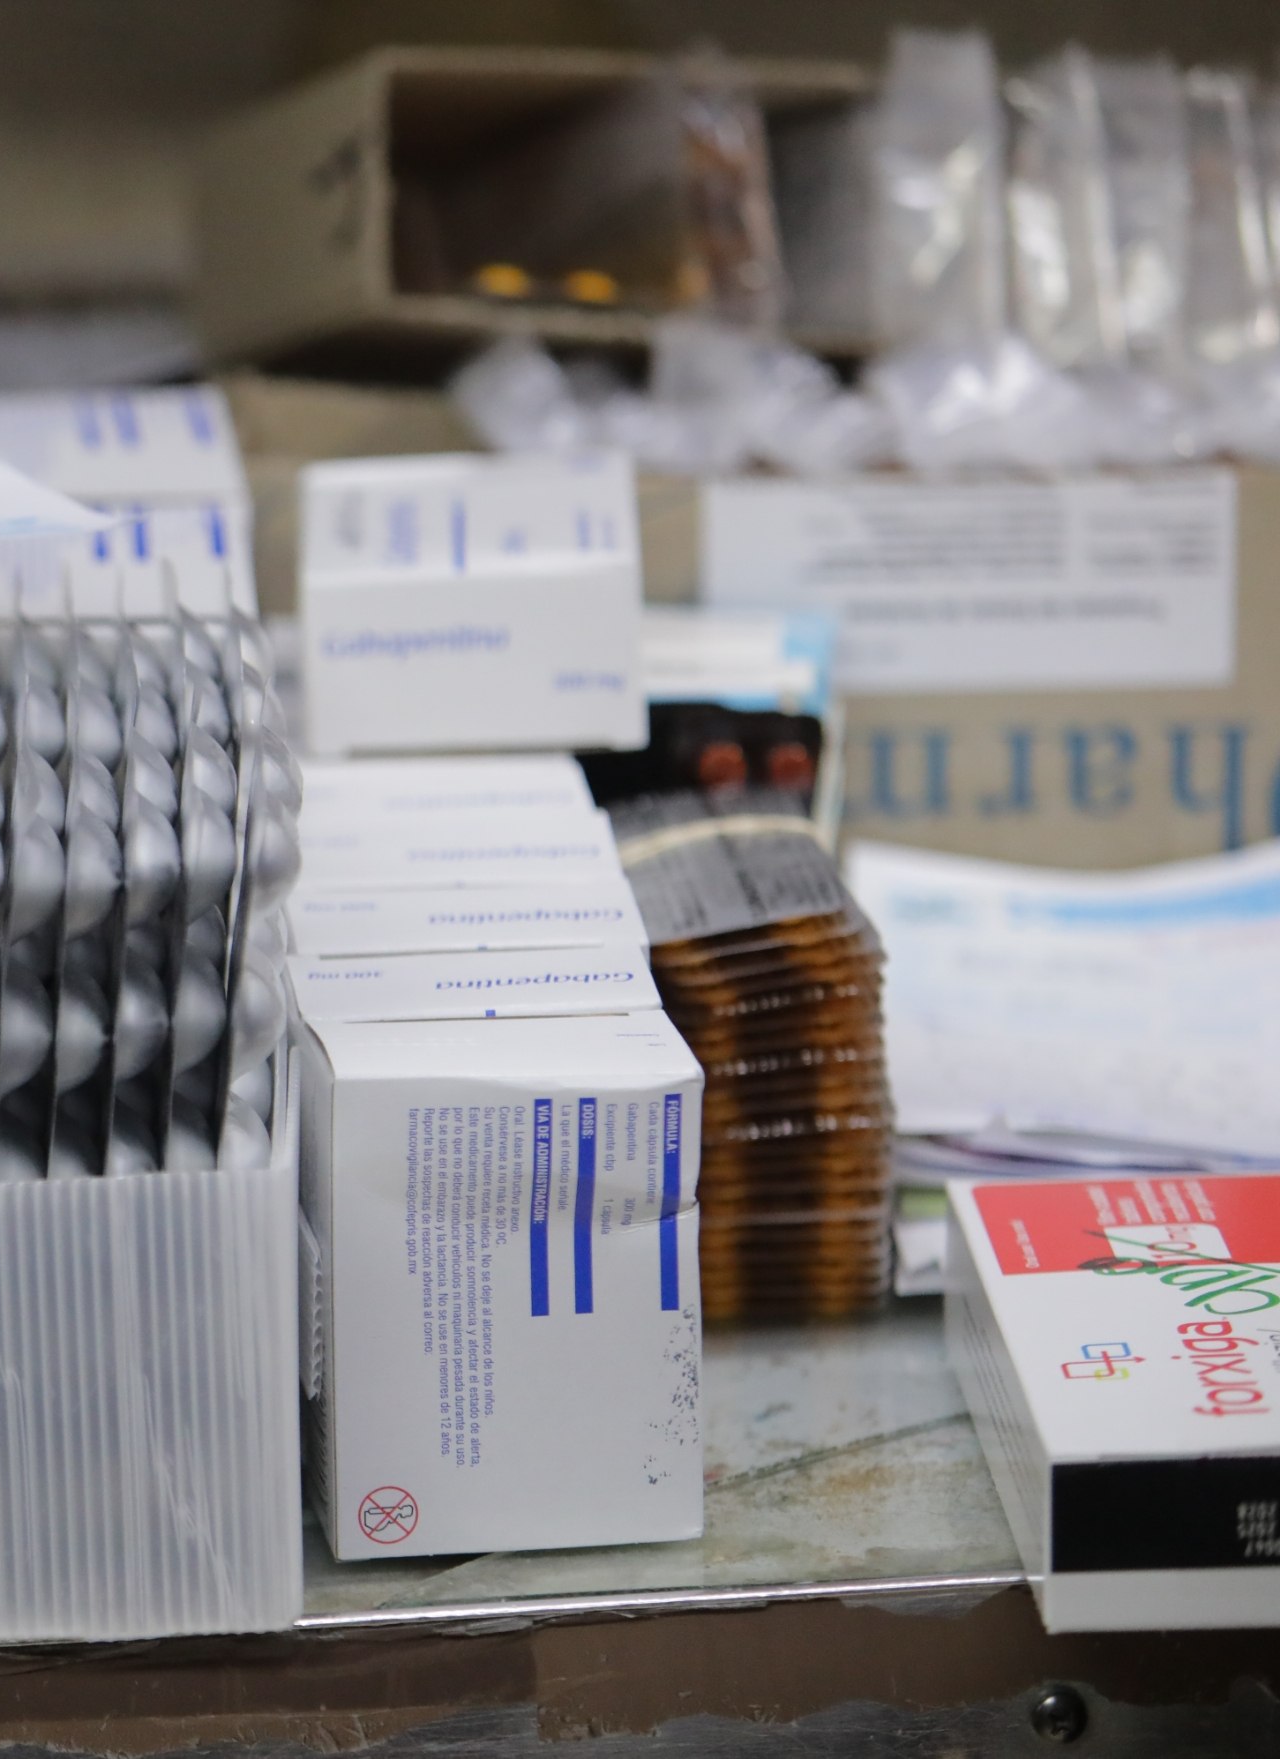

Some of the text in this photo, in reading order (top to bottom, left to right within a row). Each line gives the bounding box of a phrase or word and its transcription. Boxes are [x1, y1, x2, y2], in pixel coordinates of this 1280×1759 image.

[435, 971, 635, 990] Gabapentina
[439, 1107, 450, 1121] No
[452, 1107, 463, 1123] por
[468, 1107, 480, 1128] Este
[561, 1105, 573, 1117] La
[648, 1101, 660, 1126] Cada
[422, 1107, 435, 1146] Reporte
[439, 1124, 448, 1136] se
[453, 1125, 464, 1135] lo
[559, 1119, 571, 1137] que
[581, 1104, 595, 1139] DOSIS:
[605, 1103, 618, 1150] Excipiente
[625, 1102, 639, 1161] Gabapentina
[666, 1100, 680, 1154] FÓRMULA:
[499, 1106, 511, 1162] Consérvese
[561, 1139, 572, 1148] el
[423, 1148, 435, 1162] las
[439, 1138, 449, 1155] use
[452, 1137, 463, 1155] que
[513, 1131, 526, 1159] Léase
[439, 1157, 448, 1169] en
[453, 1157, 462, 1169] no
[467, 1130, 480, 1193] medicamento
[534, 1105, 551, 1225] VÍA DE ADMINISTRACIÓN:
[559, 1150, 572, 1184] médico
[604, 1154, 616, 1172] cbp
[439, 1171, 450, 1180] el
[498, 1172, 507, 1184] no
[511, 1161, 525, 1206] instructivo
[405, 1107, 420, 1276] farmacovigilancia@cofepris.gob.mx
[421, 1164, 435, 1211] sospechas
[452, 1171, 464, 1201] deberá
[497, 1185, 508, 1204] más
[436, 1181, 449, 1223] embarazo
[465, 1195, 477, 1220] puede
[496, 1205, 507, 1217] de
[421, 1213, 433, 1225] de
[451, 1202, 463, 1241] conducir
[495, 1217, 507, 1230] 30
[620, 1213, 632, 1226] mg
[421, 1227, 433, 1268] reacción
[437, 1233, 448, 1242] la
[465, 1223, 478, 1261] producir
[480, 1106, 496, 1418] Su venta requiere receta médica. No se deje al alcance de los niños.
[422, 1270, 433, 1308] adversa
[453, 1291, 463, 1301] ni
[466, 1265, 479, 1326] somnolencia
[437, 1293, 449, 1306] No
[423, 1310, 434, 1319] al
[438, 1309, 448, 1321] se
[439, 1323, 448, 1341] use
[451, 1303, 464, 1356] maquinaria
[439, 1343, 449, 1355] en
[467, 1339, 480, 1372] afectar
[439, 1357, 449, 1400] menores
[452, 1357, 465, 1393] pesada
[1170, 1320, 1271, 1418] forxiga
[468, 1375, 480, 1384] el
[440, 1402, 451, 1414] de
[469, 1386, 480, 1419] estado
[440, 1417, 451, 1429] 12
[454, 1395, 466, 1431] durante
[469, 1422, 480, 1434] de
[455, 1433, 465, 1445] su
[455, 1447, 466, 1468] uso.
[469, 1437, 481, 1468] alerta,
